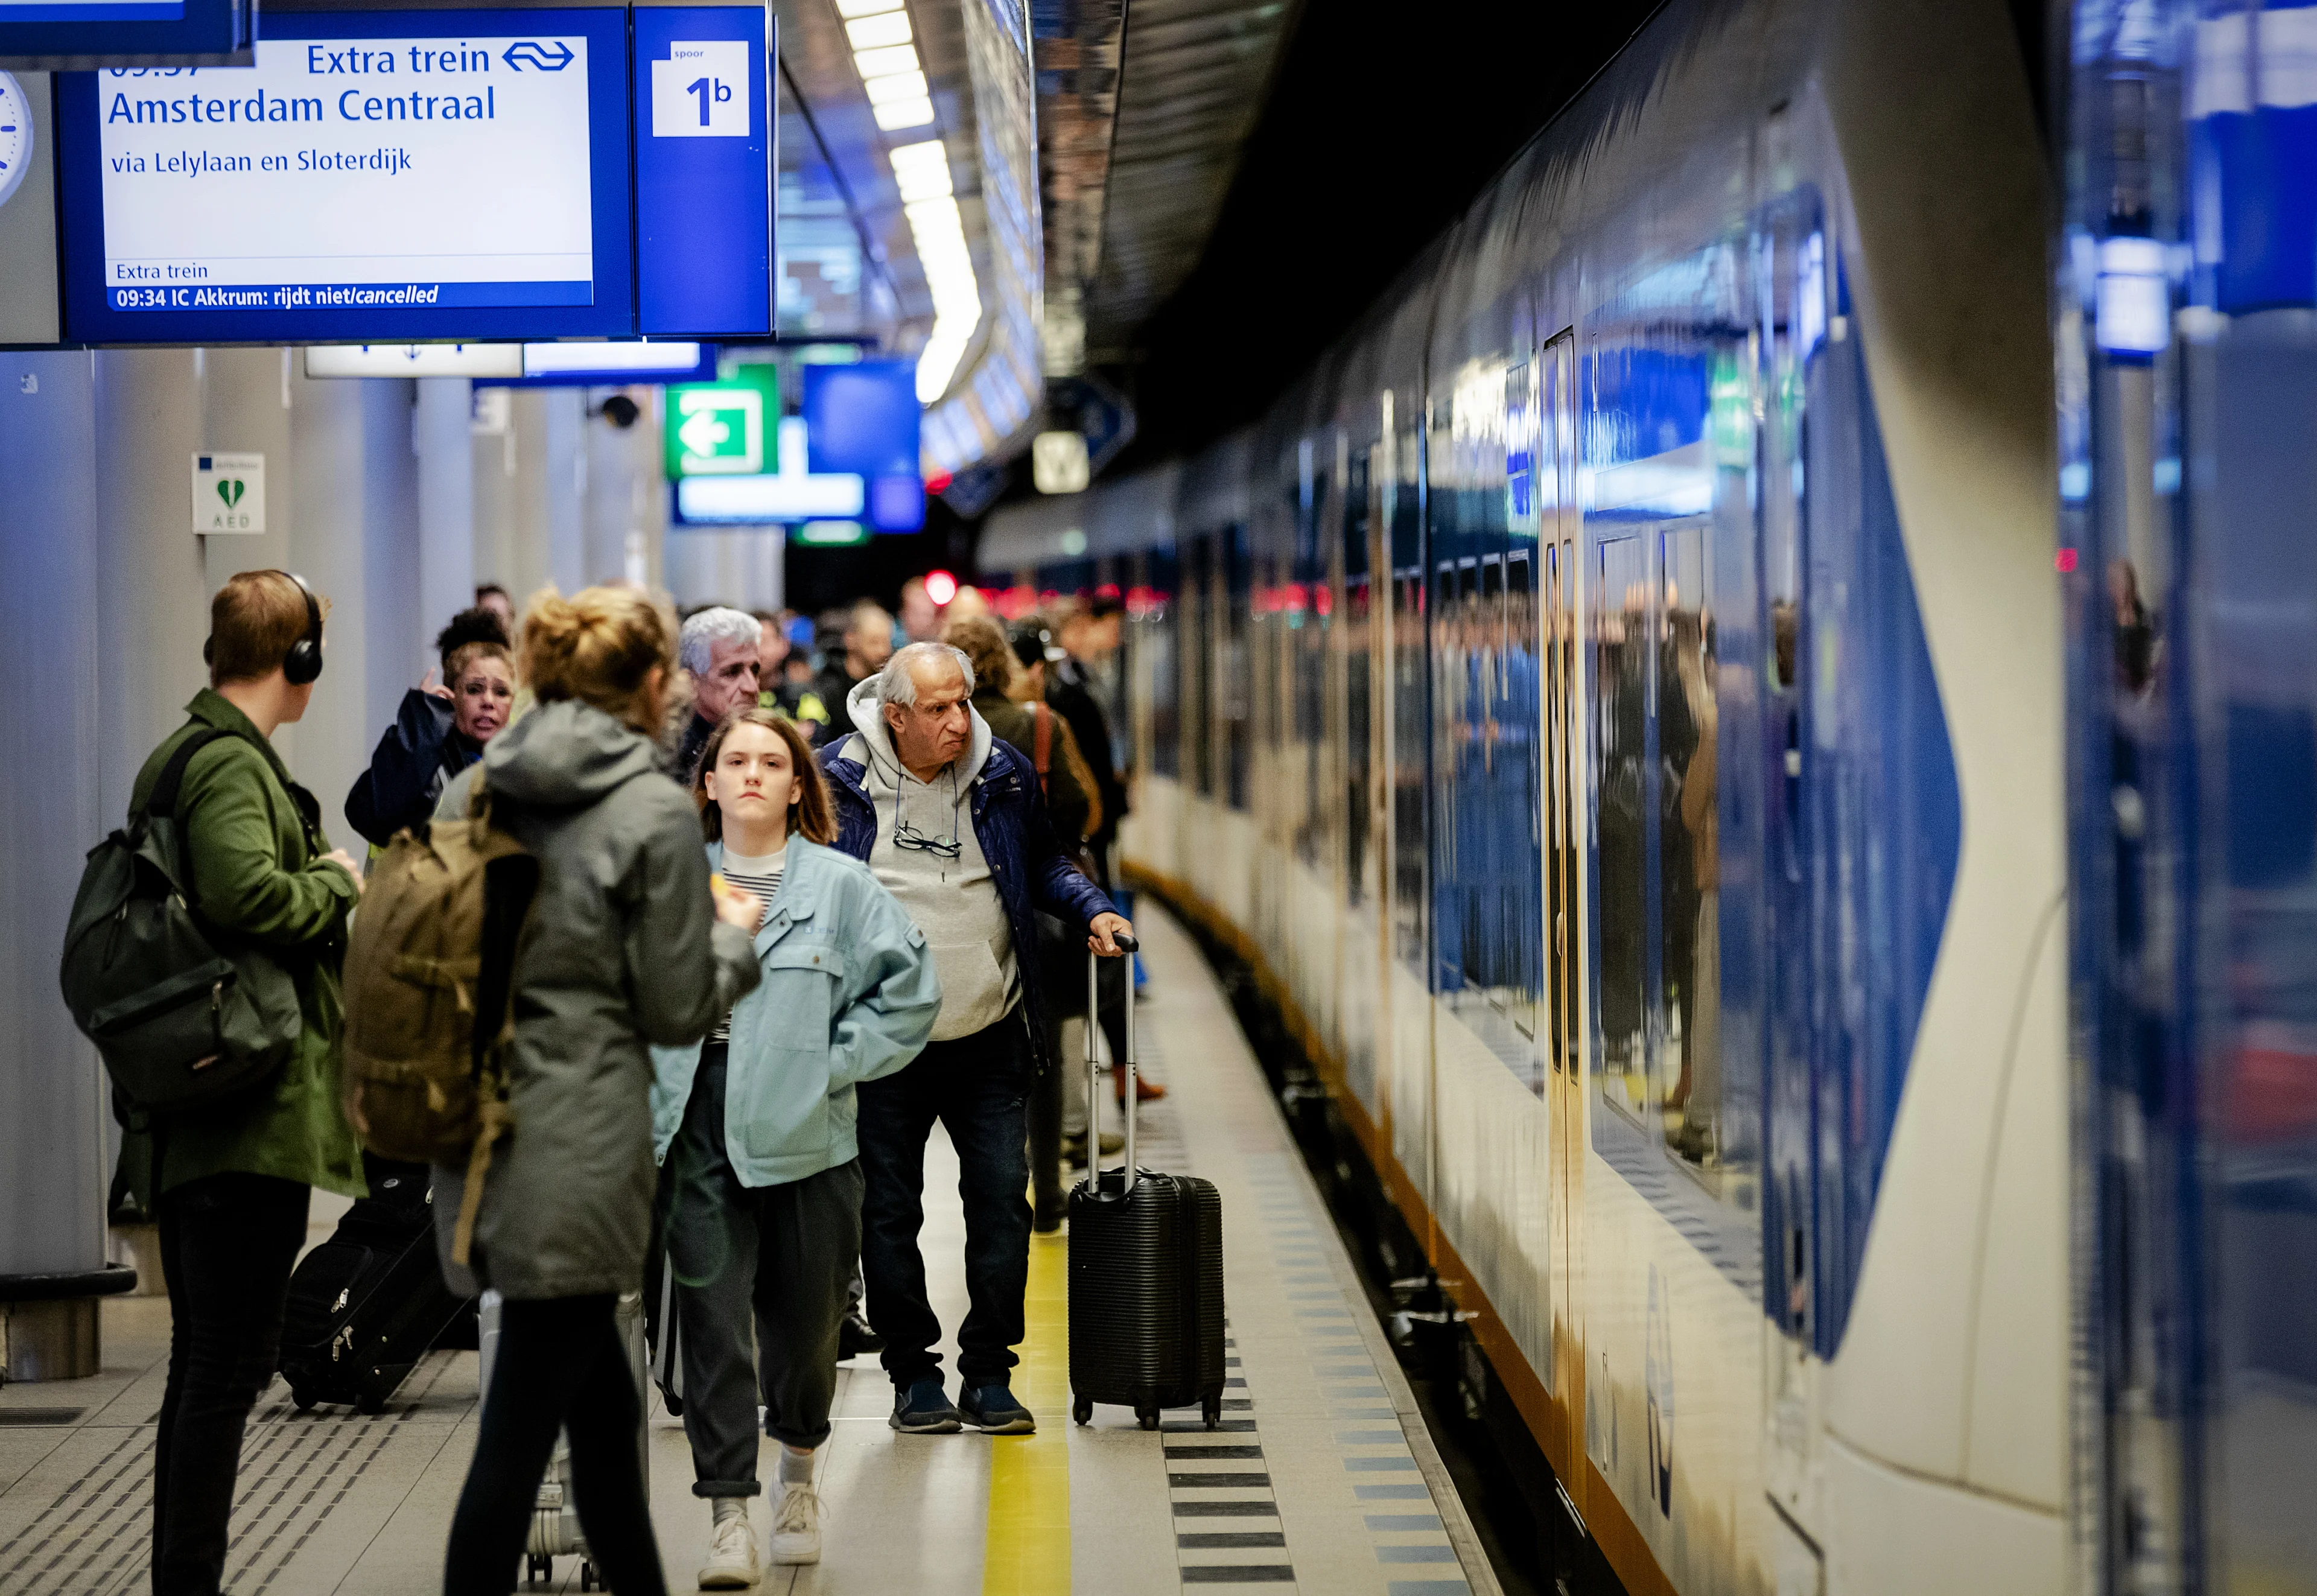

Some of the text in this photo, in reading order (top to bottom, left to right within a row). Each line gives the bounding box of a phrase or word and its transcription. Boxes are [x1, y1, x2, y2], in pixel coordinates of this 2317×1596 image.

[308, 42, 490, 74] Extra trein
[675, 51, 704, 59] spoor
[108, 86, 494, 124] Amsterdam Centraal
[112, 148, 411, 178] via Lelylaan en Sloterdijk
[117, 262, 208, 279] Extra trein
[116, 285, 439, 310] 09:34 IC Akkrum: rijdt niet/cancelled
